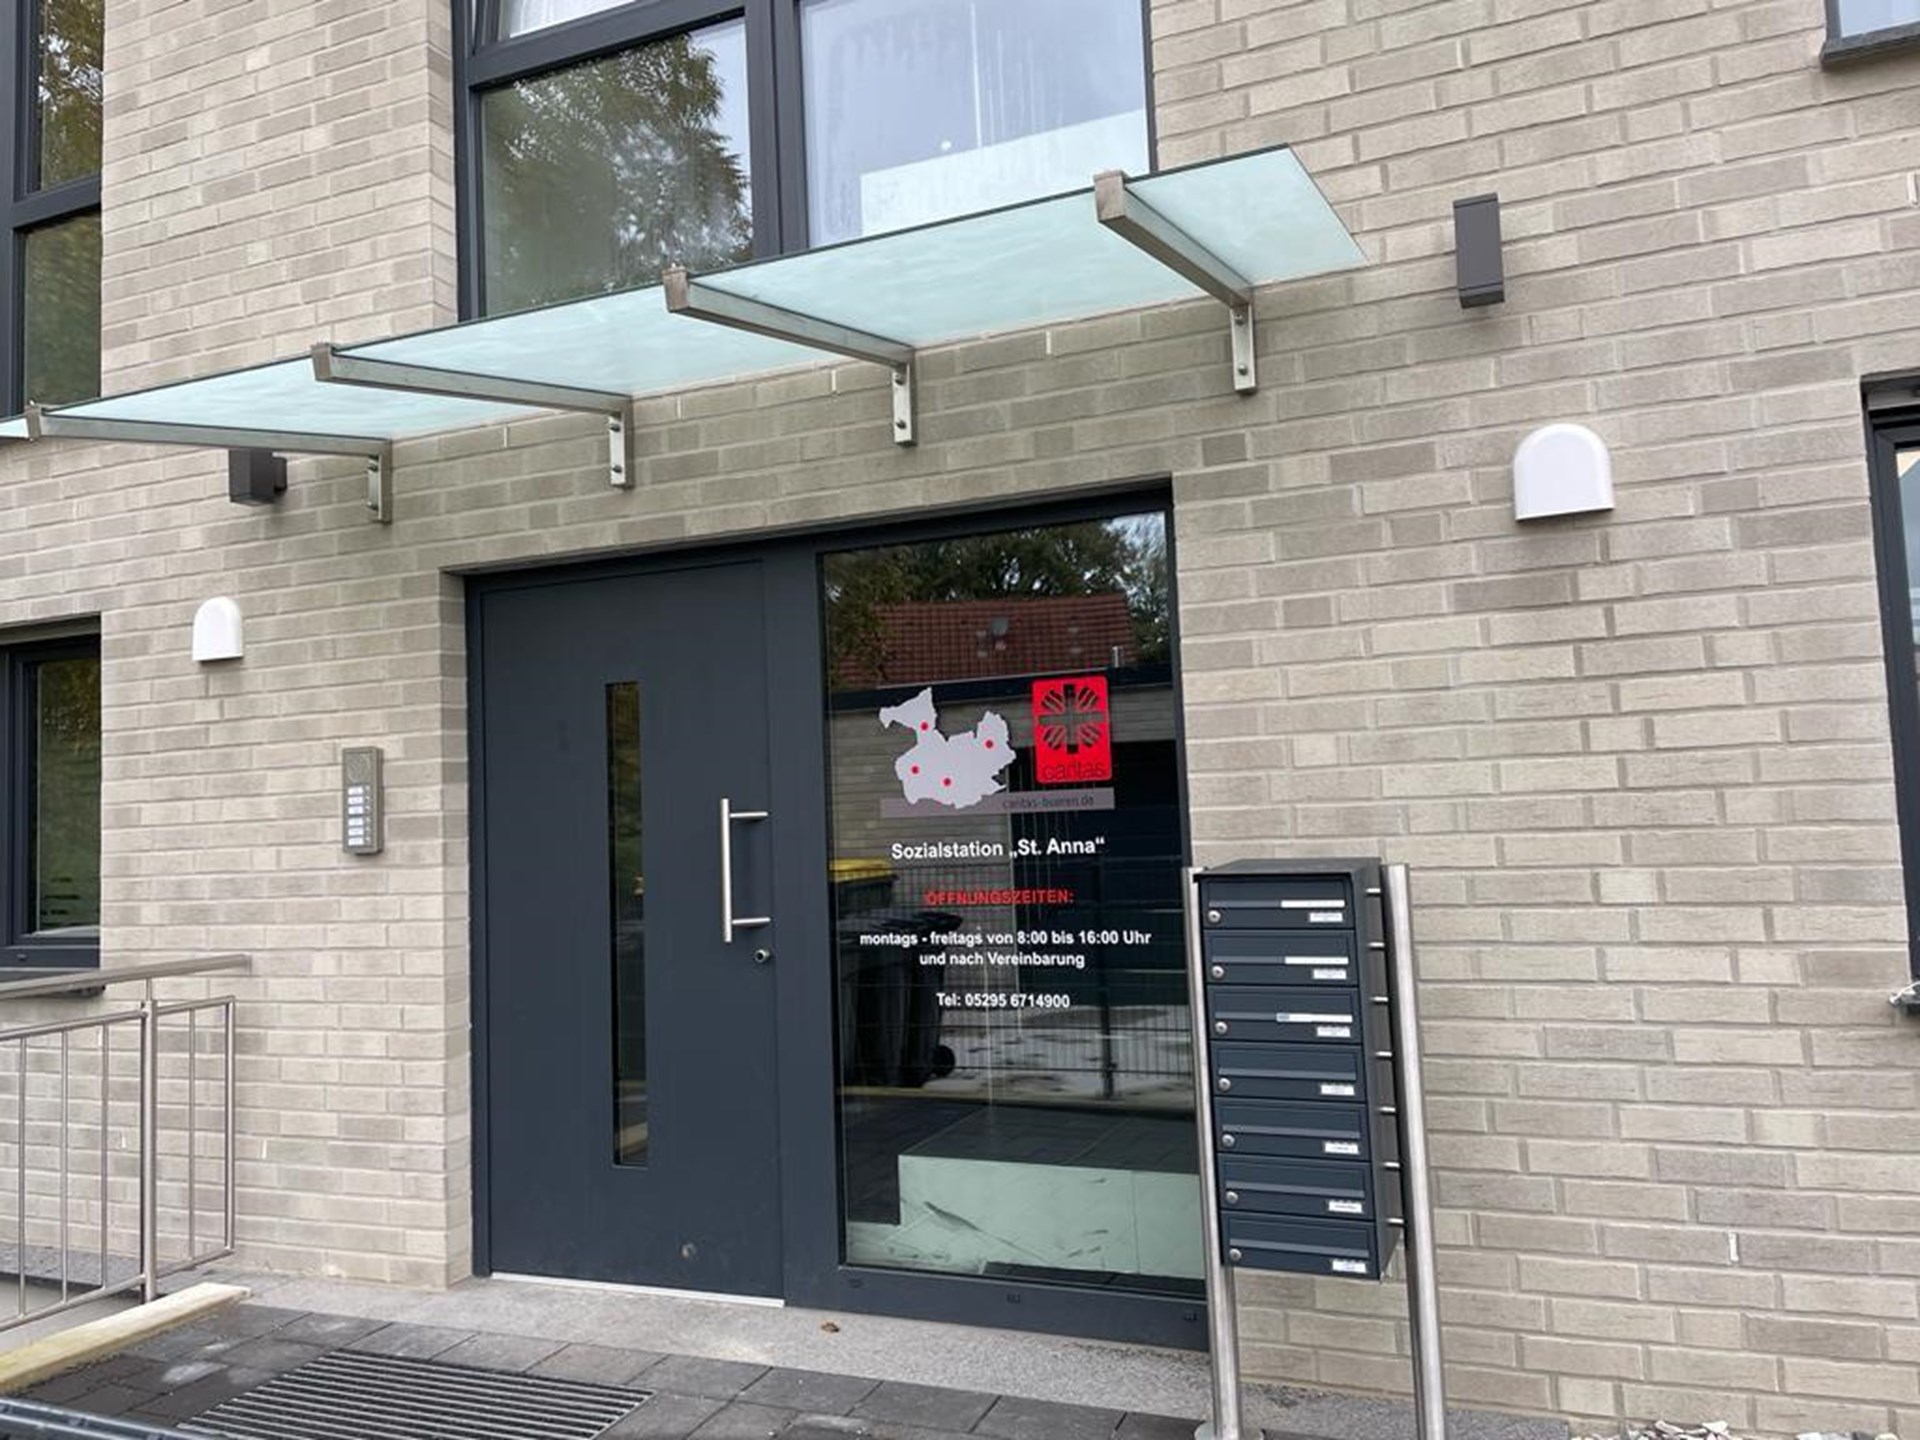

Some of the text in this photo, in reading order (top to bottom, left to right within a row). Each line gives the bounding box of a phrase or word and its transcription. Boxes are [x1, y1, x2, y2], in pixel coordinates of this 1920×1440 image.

[891, 841, 1003, 860] Sozialstation
[859, 932, 919, 948] montags
[930, 931, 983, 948] freitags
[986, 933, 1014, 944] von
[1017, 930, 1048, 944] 8:00
[1051, 930, 1075, 944] bis
[1078, 930, 1119, 944] 16:00
[1122, 930, 1152, 944] Uhr
[919, 951, 1086, 969] und nach Vereinbarung
[936, 992, 1070, 1008] Tel: 05295 6714900
